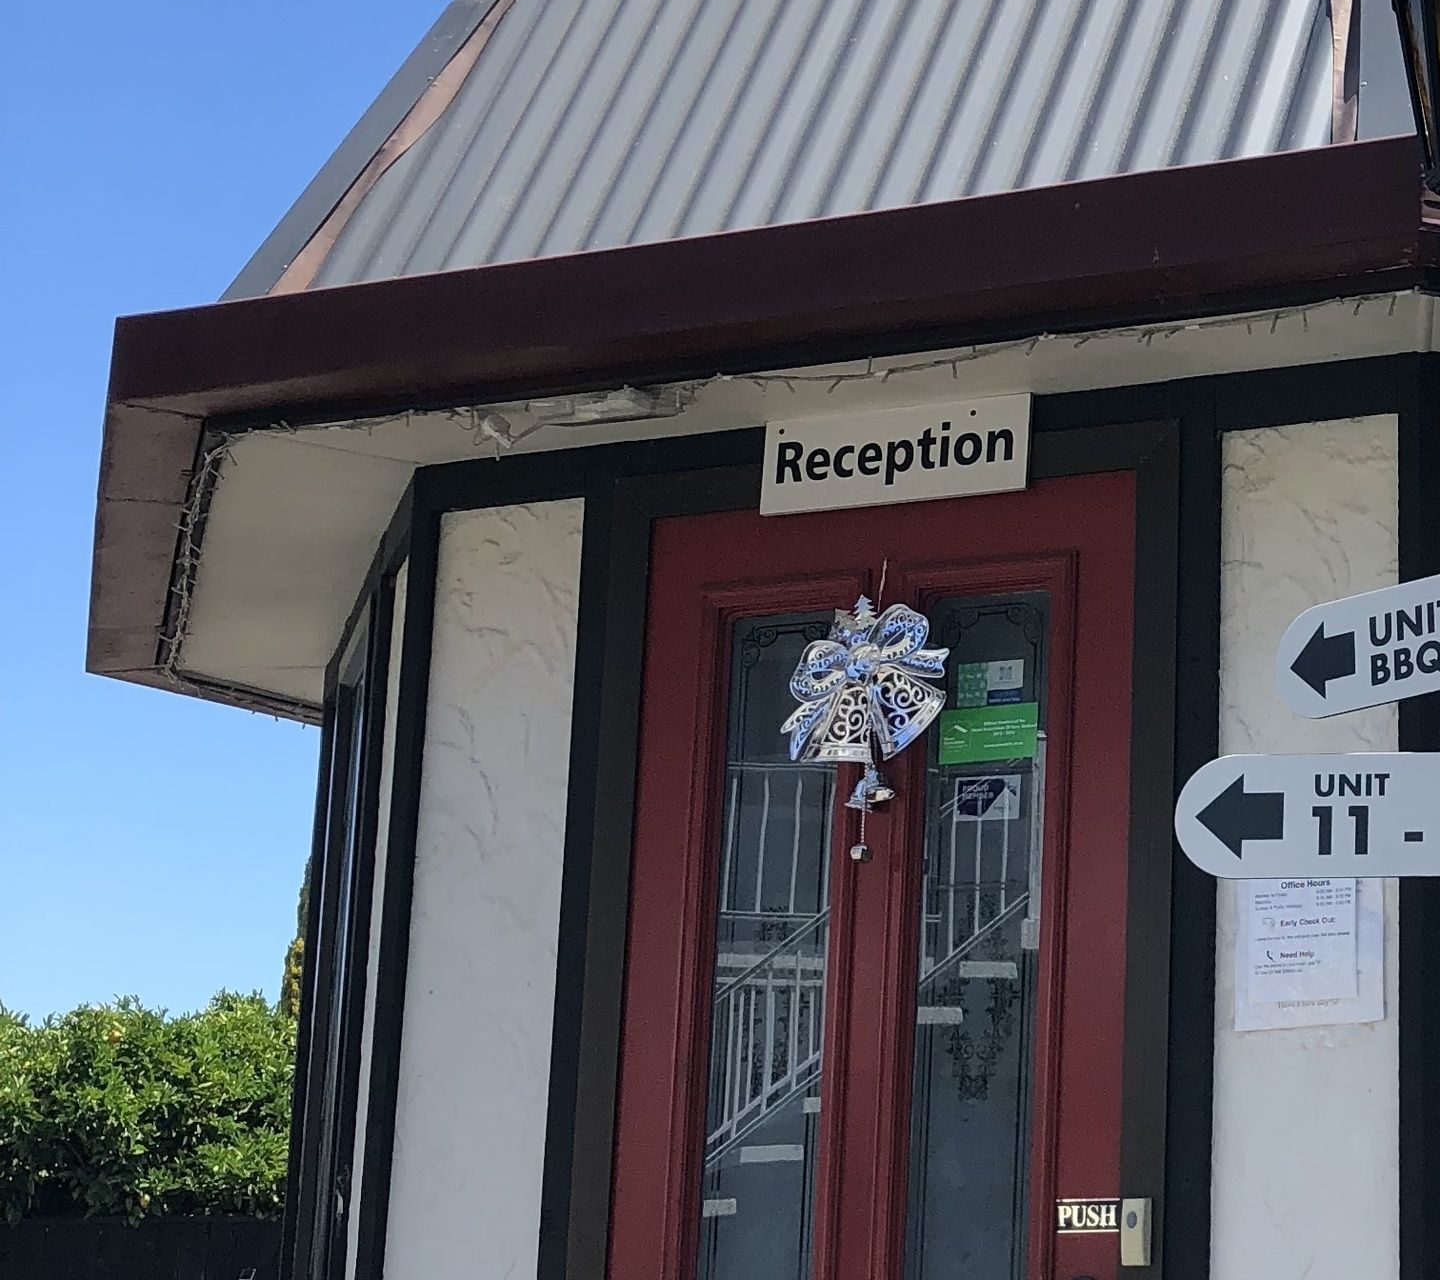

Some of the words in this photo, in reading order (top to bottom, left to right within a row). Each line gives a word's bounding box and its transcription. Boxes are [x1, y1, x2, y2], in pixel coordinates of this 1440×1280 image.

[775, 421, 1014, 486] Reception
[1314, 773, 1391, 798] UNIT
[1311, 805, 1370, 856] 11
[1280, 881, 1306, 890] Office
[1306, 879, 1331, 888] Hours
[1280, 919, 1297, 928] Early
[1299, 917, 1320, 926] Check
[1279, 951, 1298, 959] Need
[1299, 950, 1315, 959] Help
[1057, 1204, 1117, 1228] PUSH
